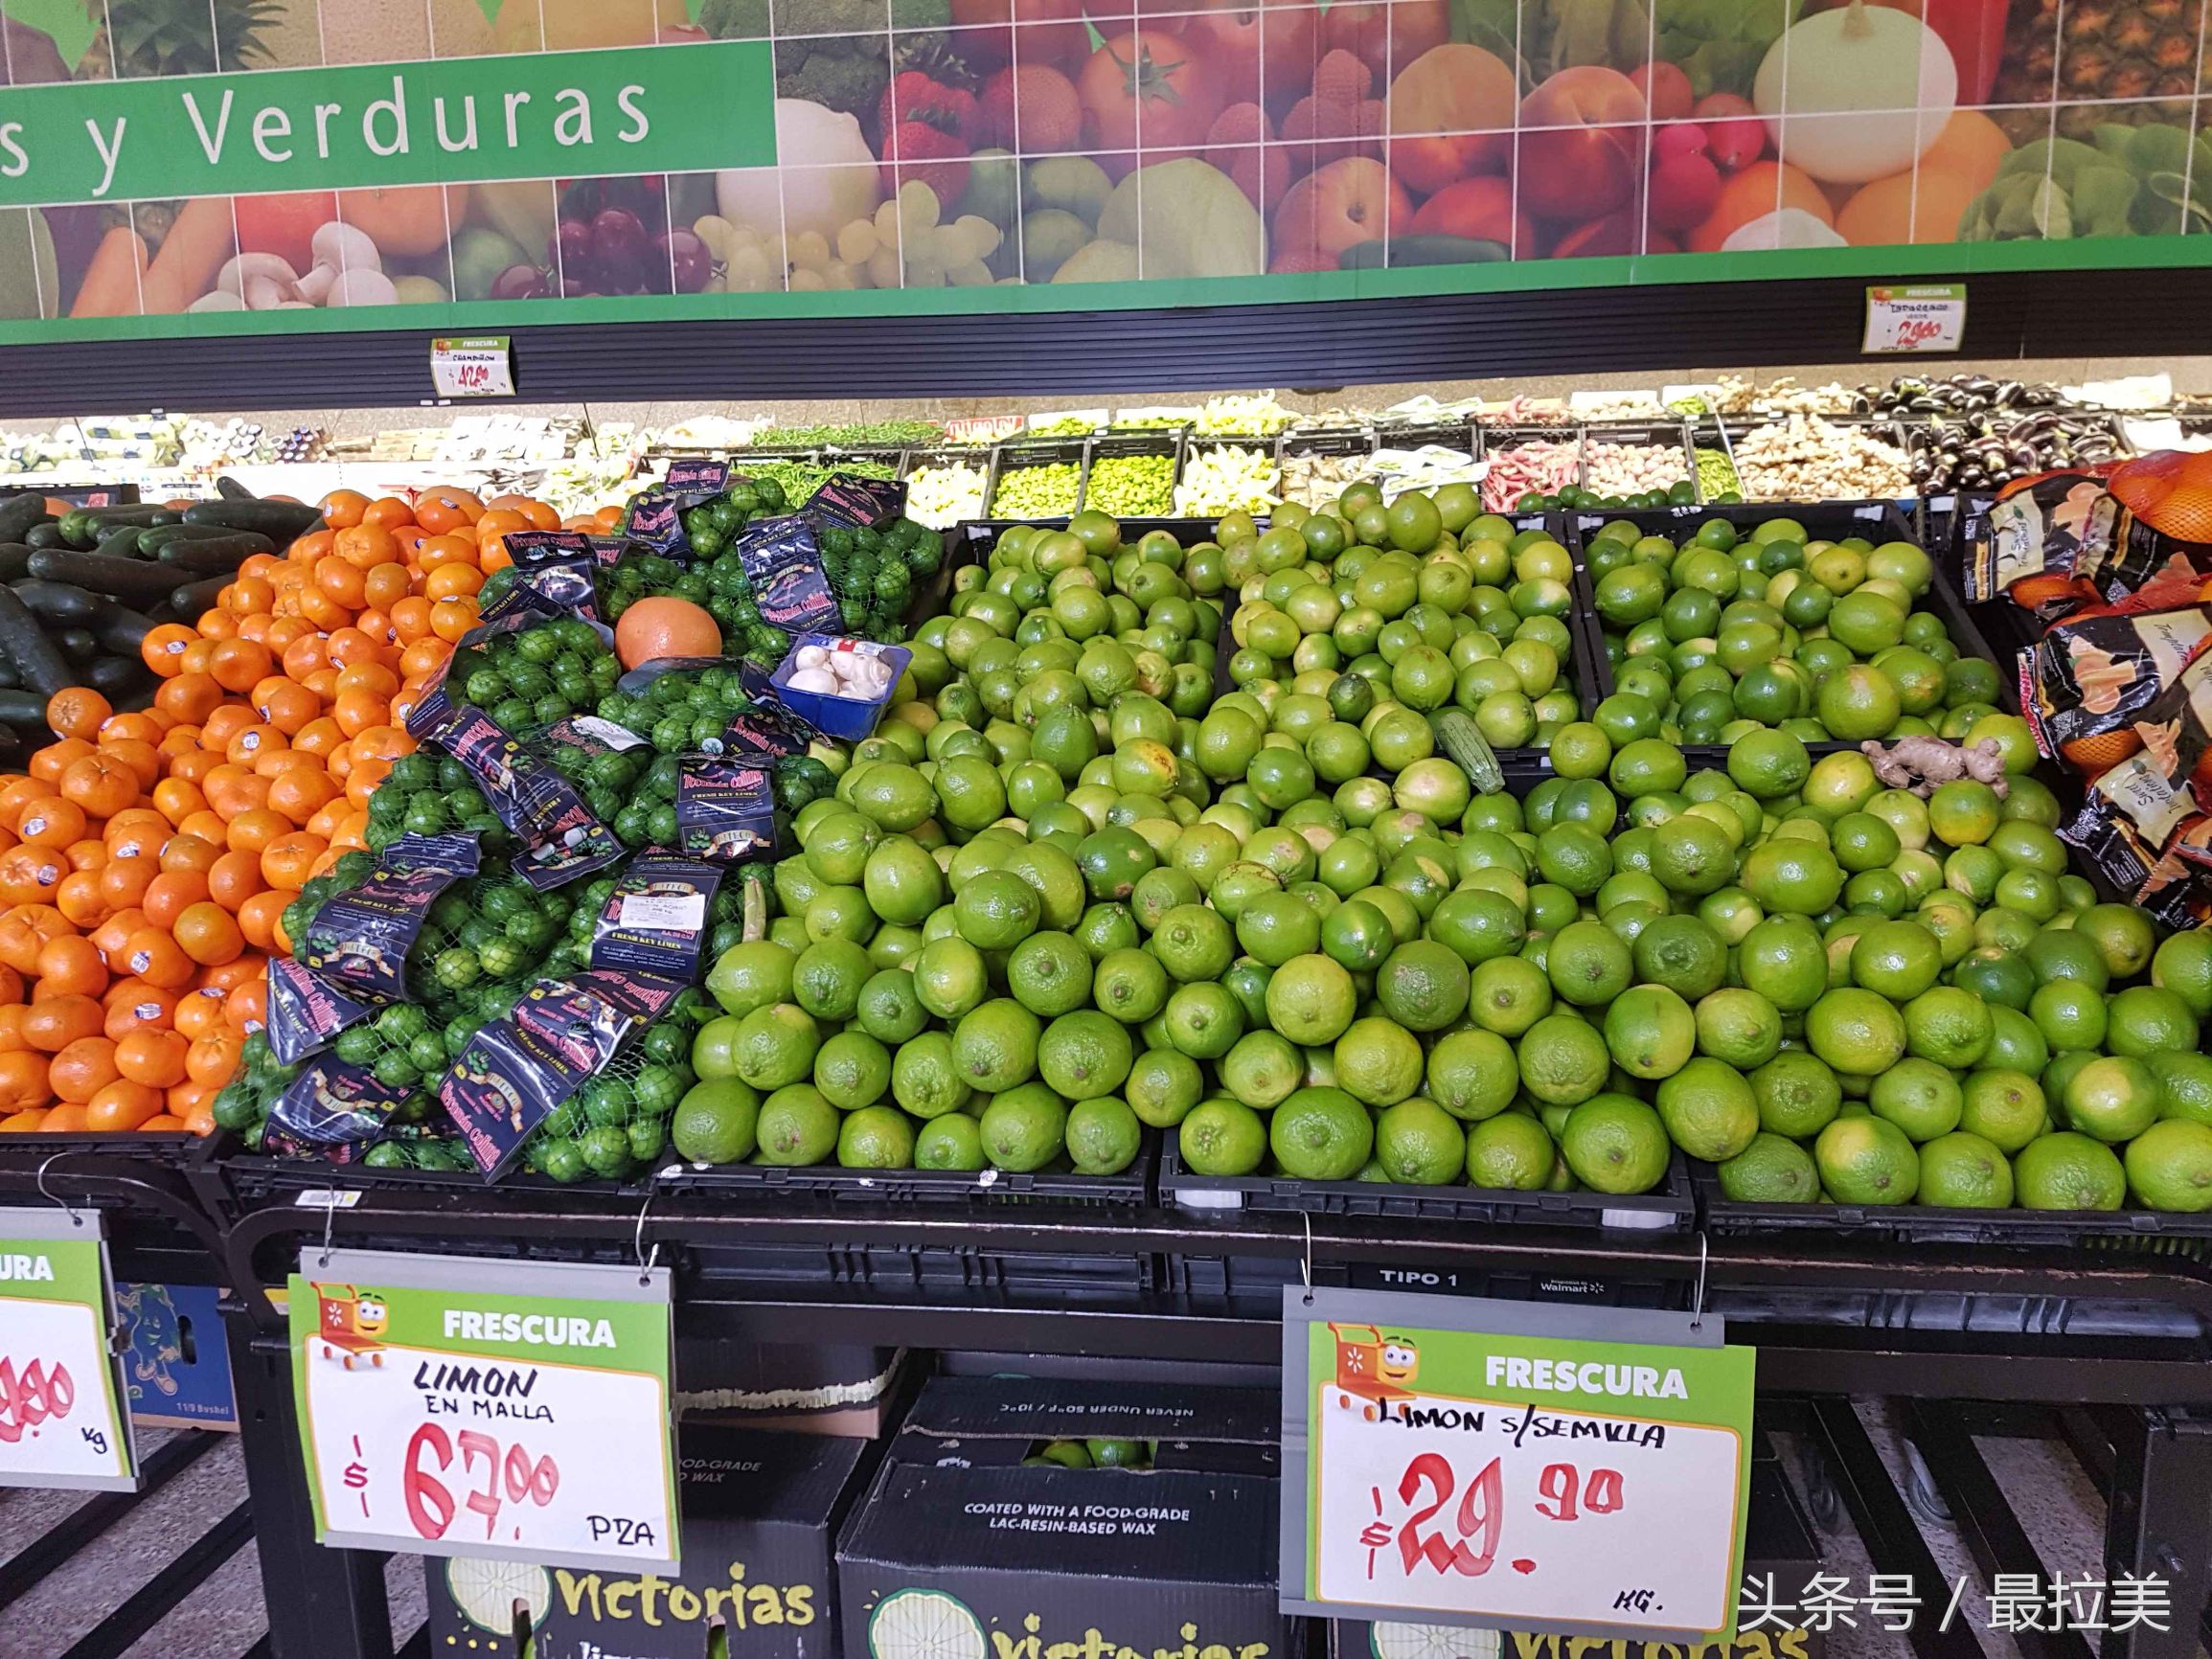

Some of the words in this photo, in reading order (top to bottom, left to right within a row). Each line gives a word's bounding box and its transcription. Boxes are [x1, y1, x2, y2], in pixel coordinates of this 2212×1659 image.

[85, 116, 126, 196] y
[182, 76, 650, 167] Verduras
[1380, 1269, 1439, 1286] TIPO
[1448, 1274, 1458, 1287] 1
[1540, 1282, 1588, 1293] Walmart
[444, 1309, 617, 1348] FRESCURA
[413, 1361, 539, 1398] LIMON
[1486, 1355, 1688, 1400] FRESCURA
[424, 1395, 459, 1415] EN
[472, 1398, 556, 1423] MALLA
[1089, 1405, 1141, 1416] UNDER
[1146, 1408, 1195, 1417] NEVER
[1379, 1397, 1485, 1433] LIMON
[679, 1458, 763, 1472] OD-GRADE
[693, 1472, 726, 1483] WAX
[964, 1503, 1023, 1515] COATED
[1027, 1505, 1065, 1517] WITH
[1068, 1506, 1080, 1518] A
[1083, 1505, 1191, 1521] FOOD-GRADE
[586, 1515, 656, 1547] PZA
[989, 1517, 1117, 1534] LAC-RESIN-BASED
[1121, 1522, 1157, 1535] WAX
